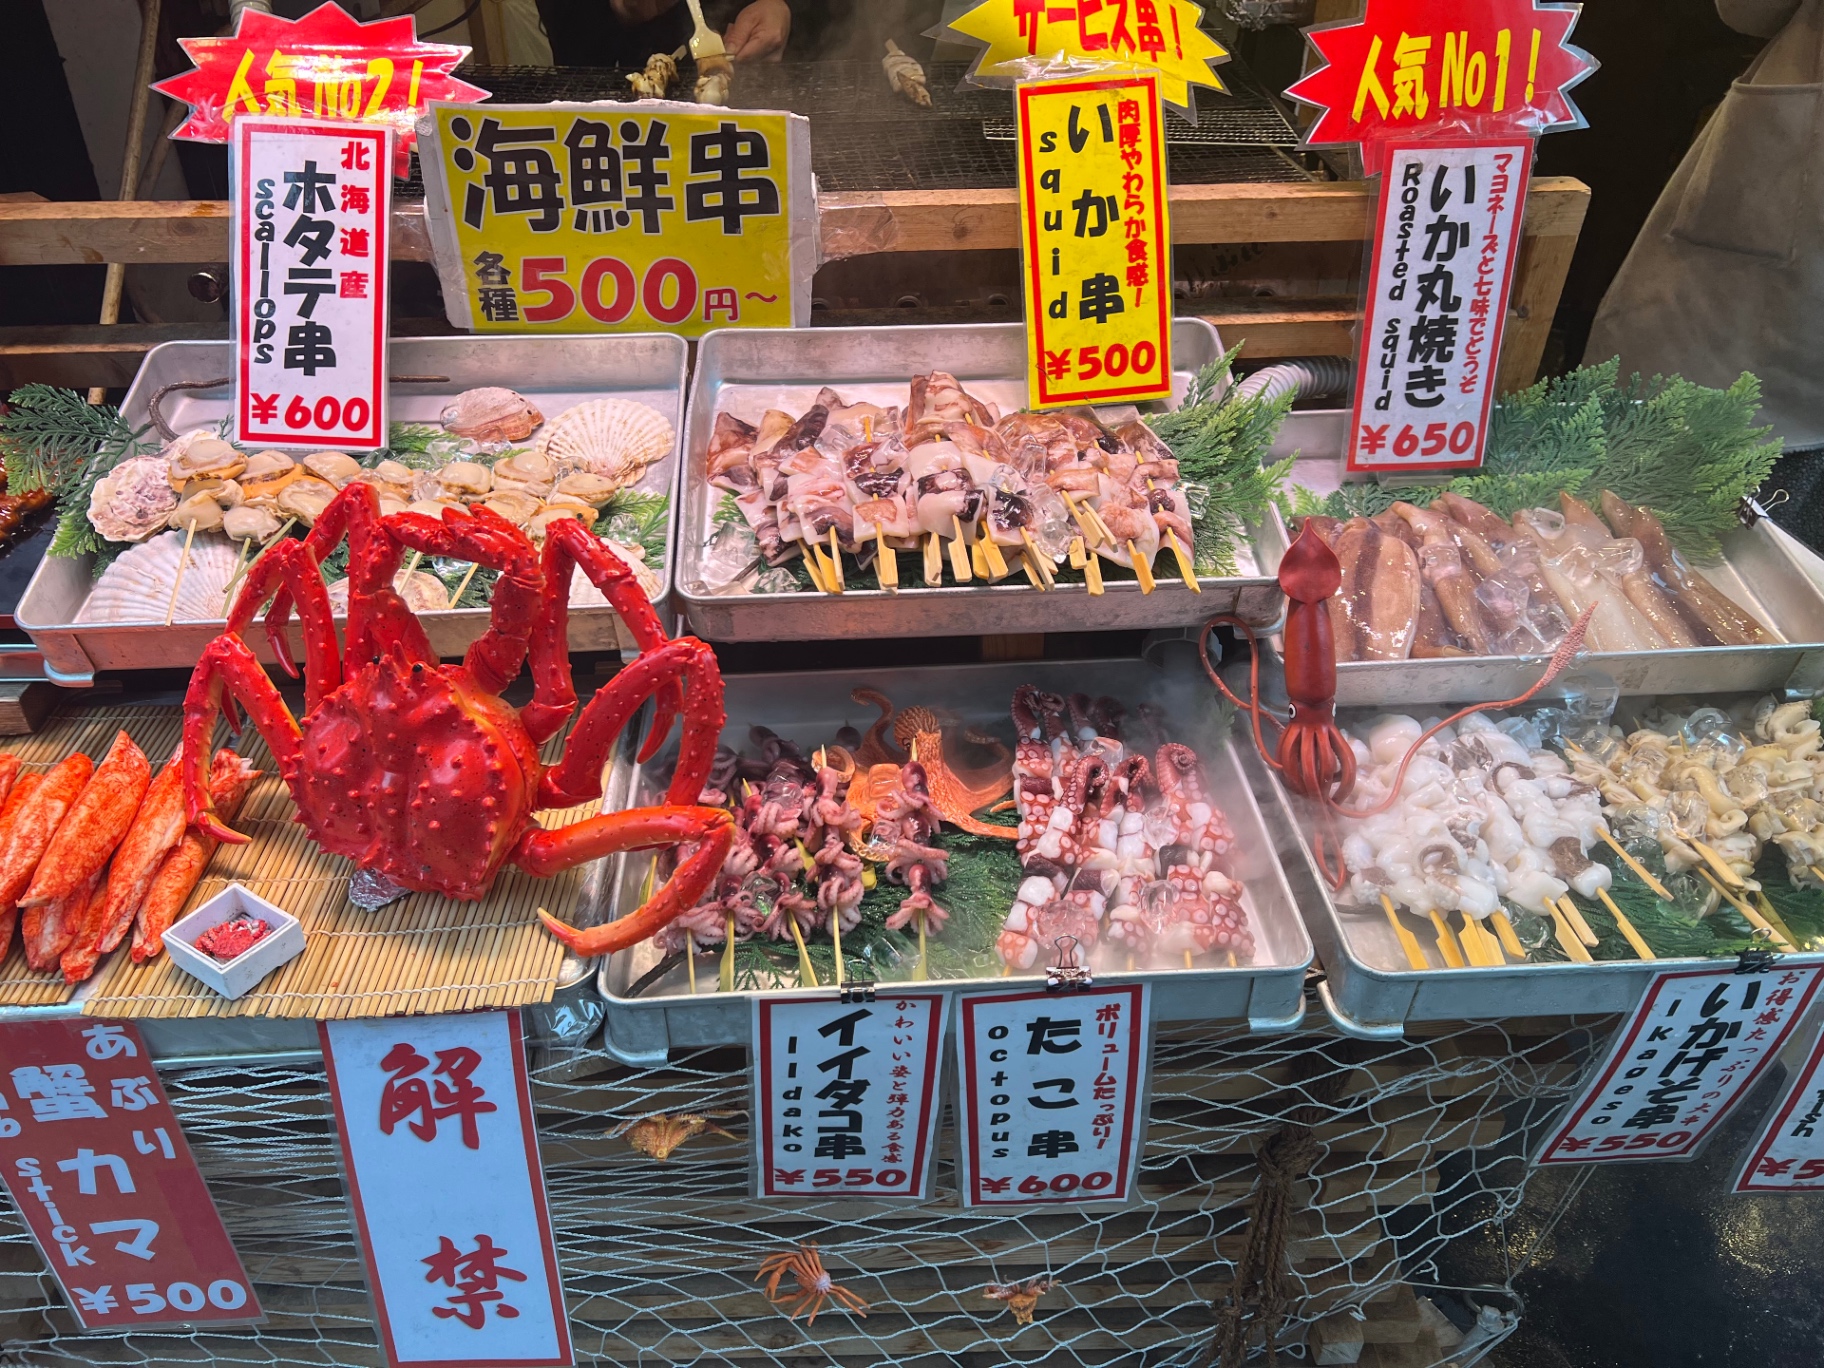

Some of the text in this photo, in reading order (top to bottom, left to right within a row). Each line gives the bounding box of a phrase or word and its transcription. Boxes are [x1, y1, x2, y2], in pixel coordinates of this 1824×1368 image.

[340, 141, 370, 299] 北海道産
[450, 116, 781, 235] 海鮮串
[1039, 130, 1069, 319] squid
[1067, 103, 1126, 324] いか串
[253, 178, 277, 364] scallops
[283, 160, 337, 377] ホタテ串
[1373, 163, 1425, 412] Roasted squid
[1404, 163, 1477, 409] いか丸焼き
[250, 392, 370, 432] ¥600
[1044, 340, 1157, 380] ¥500
[1359, 421, 1475, 458] ¥650
[81, 1023, 176, 1159] あぶり
[814, 1008, 874, 1160] イイダコ串
[987, 1025, 1012, 1158] octopus
[1026, 1016, 1083, 1159] たこ串
[1621, 980, 1762, 1129] いかげそ串
[9, 1063, 160, 1261] 蟹カマ
[15, 1157, 96, 1267] stick
[378, 1042, 528, 1330] 解禁
[774, 1168, 907, 1188] ¥550
[979, 1171, 1113, 1194] ¥600
[1559, 1131, 1692, 1153] ¥550
[71, 1279, 247, 1315] ¥500
